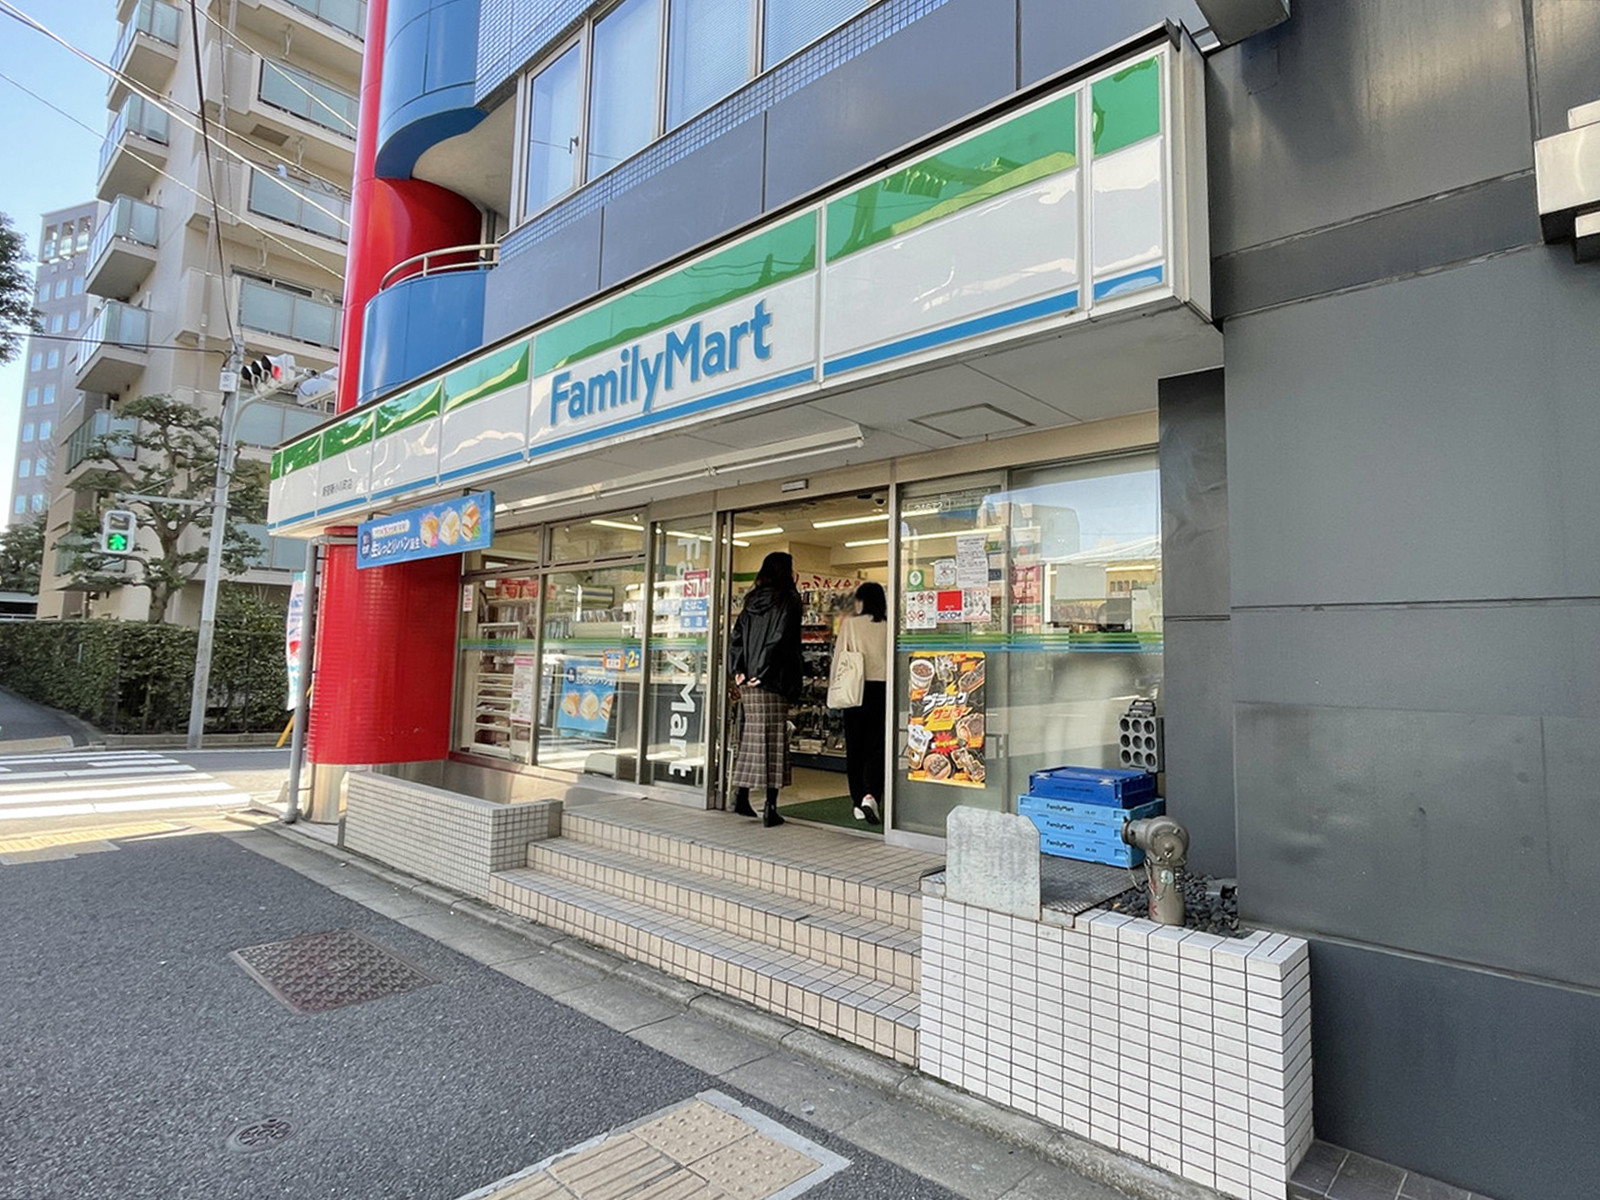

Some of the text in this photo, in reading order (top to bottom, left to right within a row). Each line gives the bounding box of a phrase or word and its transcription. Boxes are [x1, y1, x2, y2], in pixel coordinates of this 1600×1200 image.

[550, 299, 772, 426] FamilyMart
[923, 686, 968, 714] ブラック
[932, 707, 969, 720] サンダー
